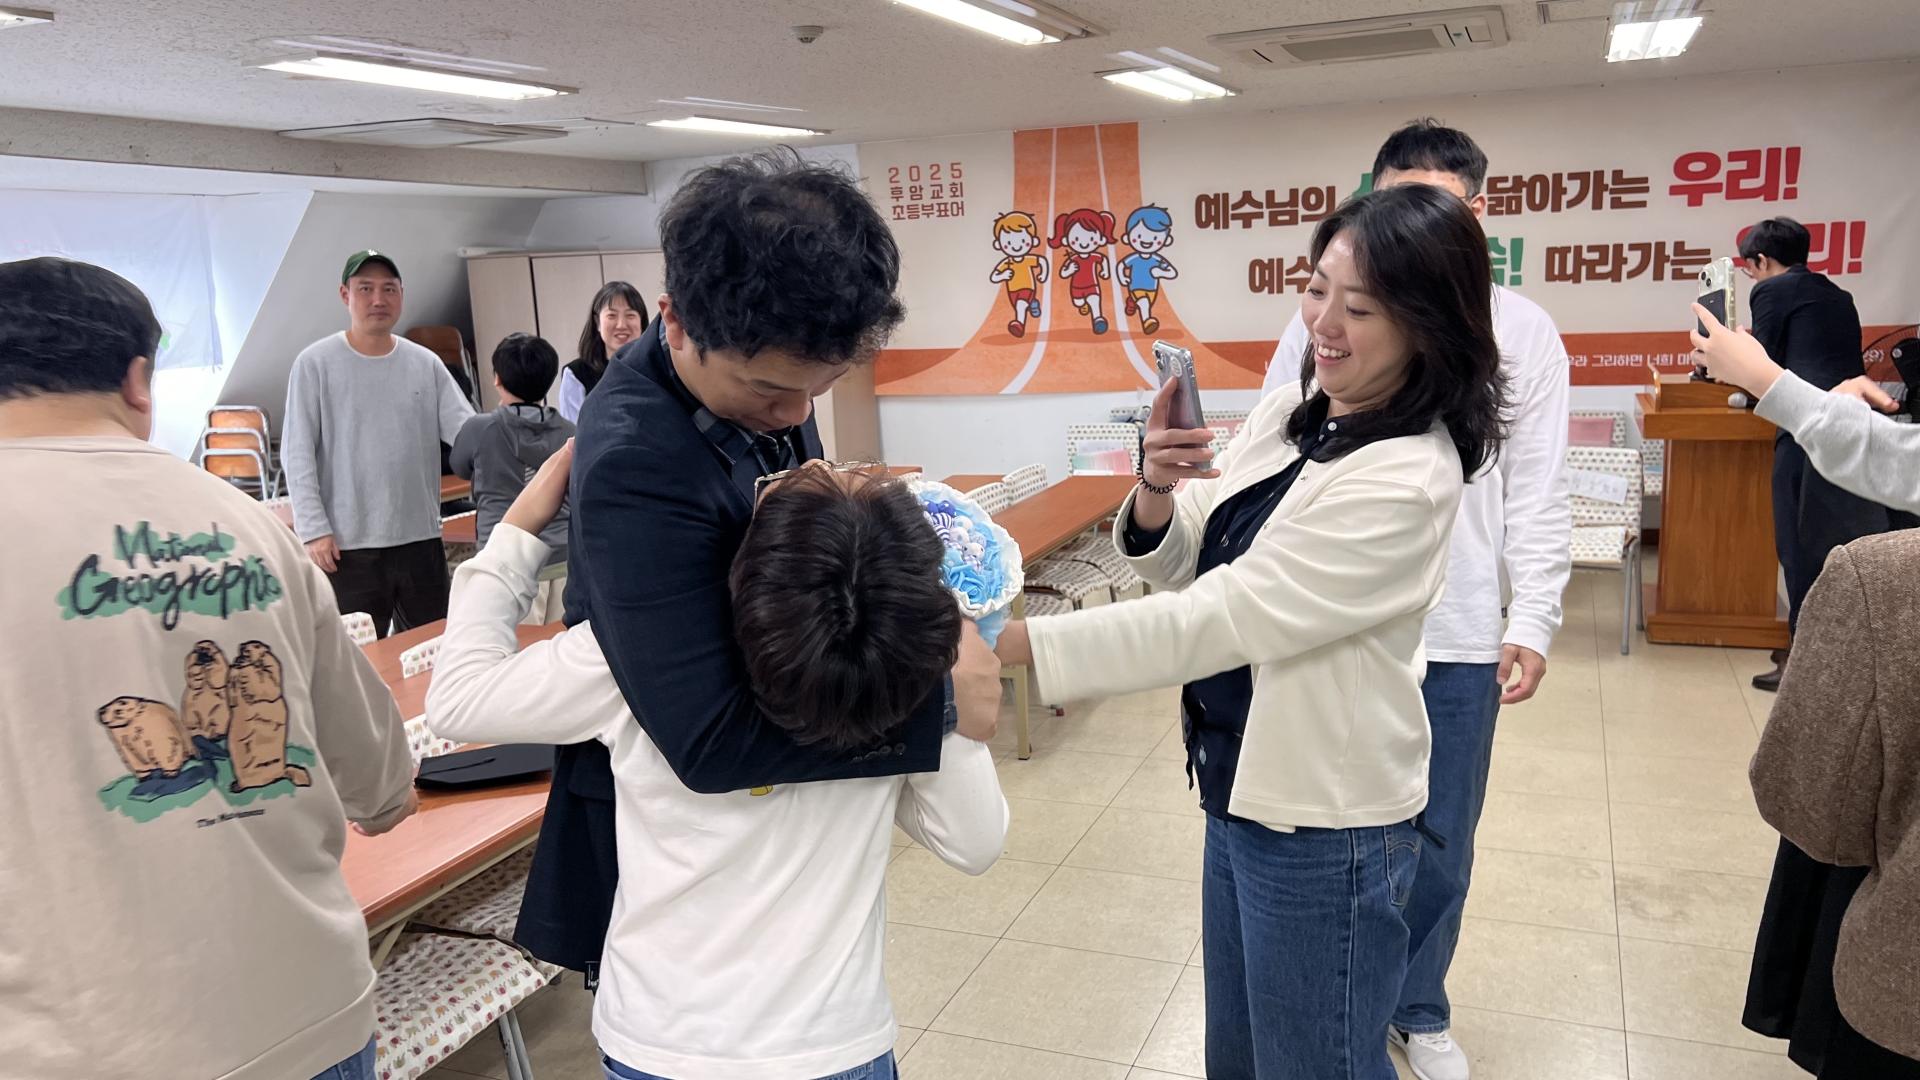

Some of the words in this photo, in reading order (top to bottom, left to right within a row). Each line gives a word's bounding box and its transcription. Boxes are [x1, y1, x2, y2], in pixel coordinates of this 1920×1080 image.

[888, 162, 962, 183] 2025
[890, 182, 964, 202] 후암교회
[1195, 185, 1336, 230] 예수님의
[1486, 169, 1650, 217] 닮아가는
[1668, 147, 1801, 206] 우리!
[892, 201, 965, 220] 초등부표어
[1248, 256, 1313, 295] 예수
[1545, 240, 1712, 284] 따라가는
[1734, 221, 1866, 275] 리!
[1591, 353, 1643, 367] 그리하면
[1647, 353, 1673, 366] 너희
